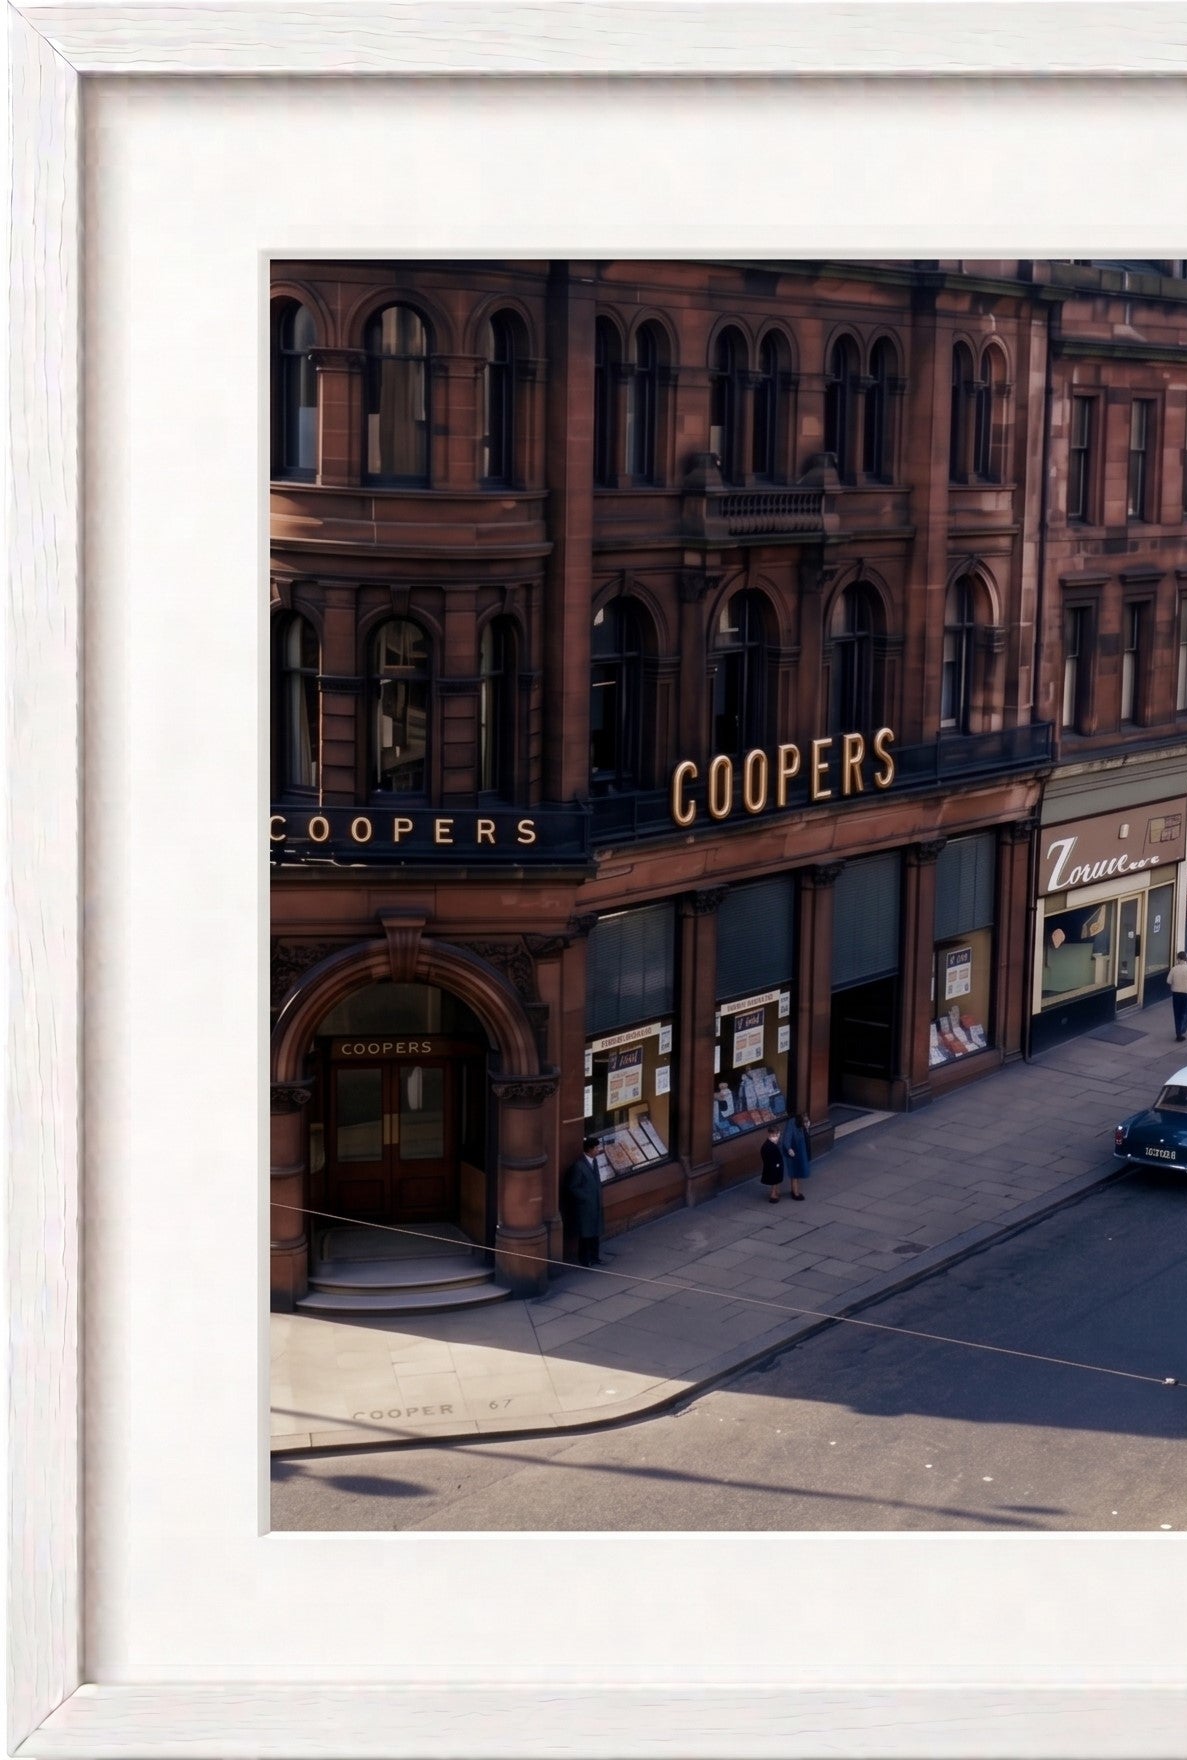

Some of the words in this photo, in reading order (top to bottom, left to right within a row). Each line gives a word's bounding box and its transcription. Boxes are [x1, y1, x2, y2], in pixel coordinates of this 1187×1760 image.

[670, 727, 896, 827] COOPERS
[270, 815, 537, 845] COOPERS
[341, 1041, 433, 1056] COOPERS
[352, 1403, 454, 1421] COOPER
[488, 1398, 513, 1411] 67
